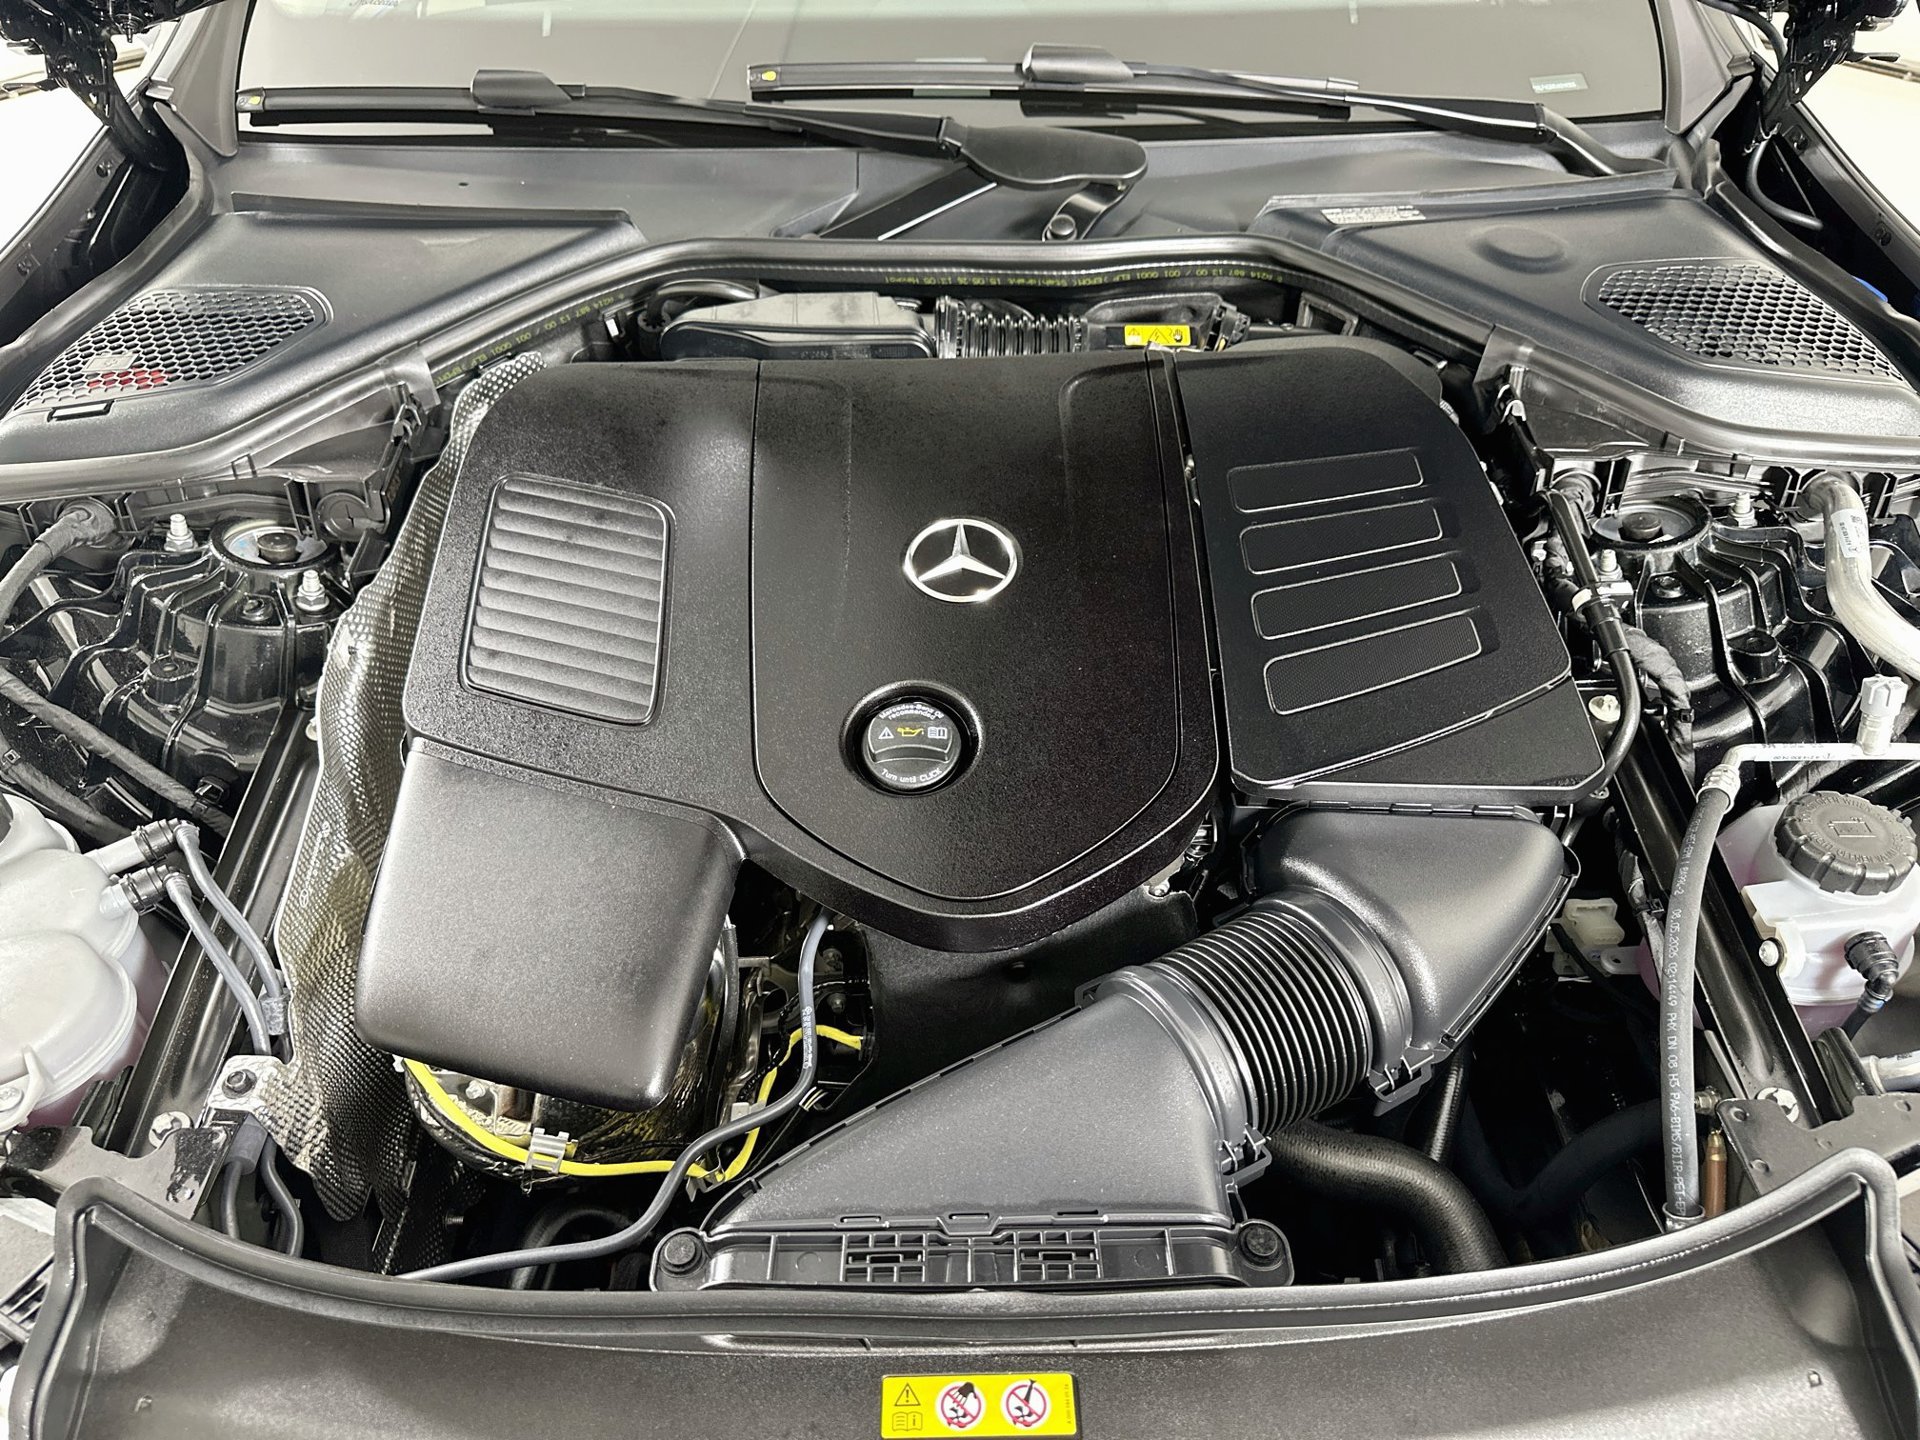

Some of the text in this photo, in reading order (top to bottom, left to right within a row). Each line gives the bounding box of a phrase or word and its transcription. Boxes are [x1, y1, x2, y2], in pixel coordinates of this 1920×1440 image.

[879, 703, 935, 719] Mercedes-Benz
[888, 709, 936, 720] recommended
[881, 767, 942, 784] Turn until CLICK
[1668, 908, 1683, 959] 08.05.2026
[1666, 961, 1679, 1007] 02:14:49
[1666, 1012, 1678, 1032] PHX
[1666, 1035, 1678, 1050] DN
[1667, 1056, 1679, 1069] 08
